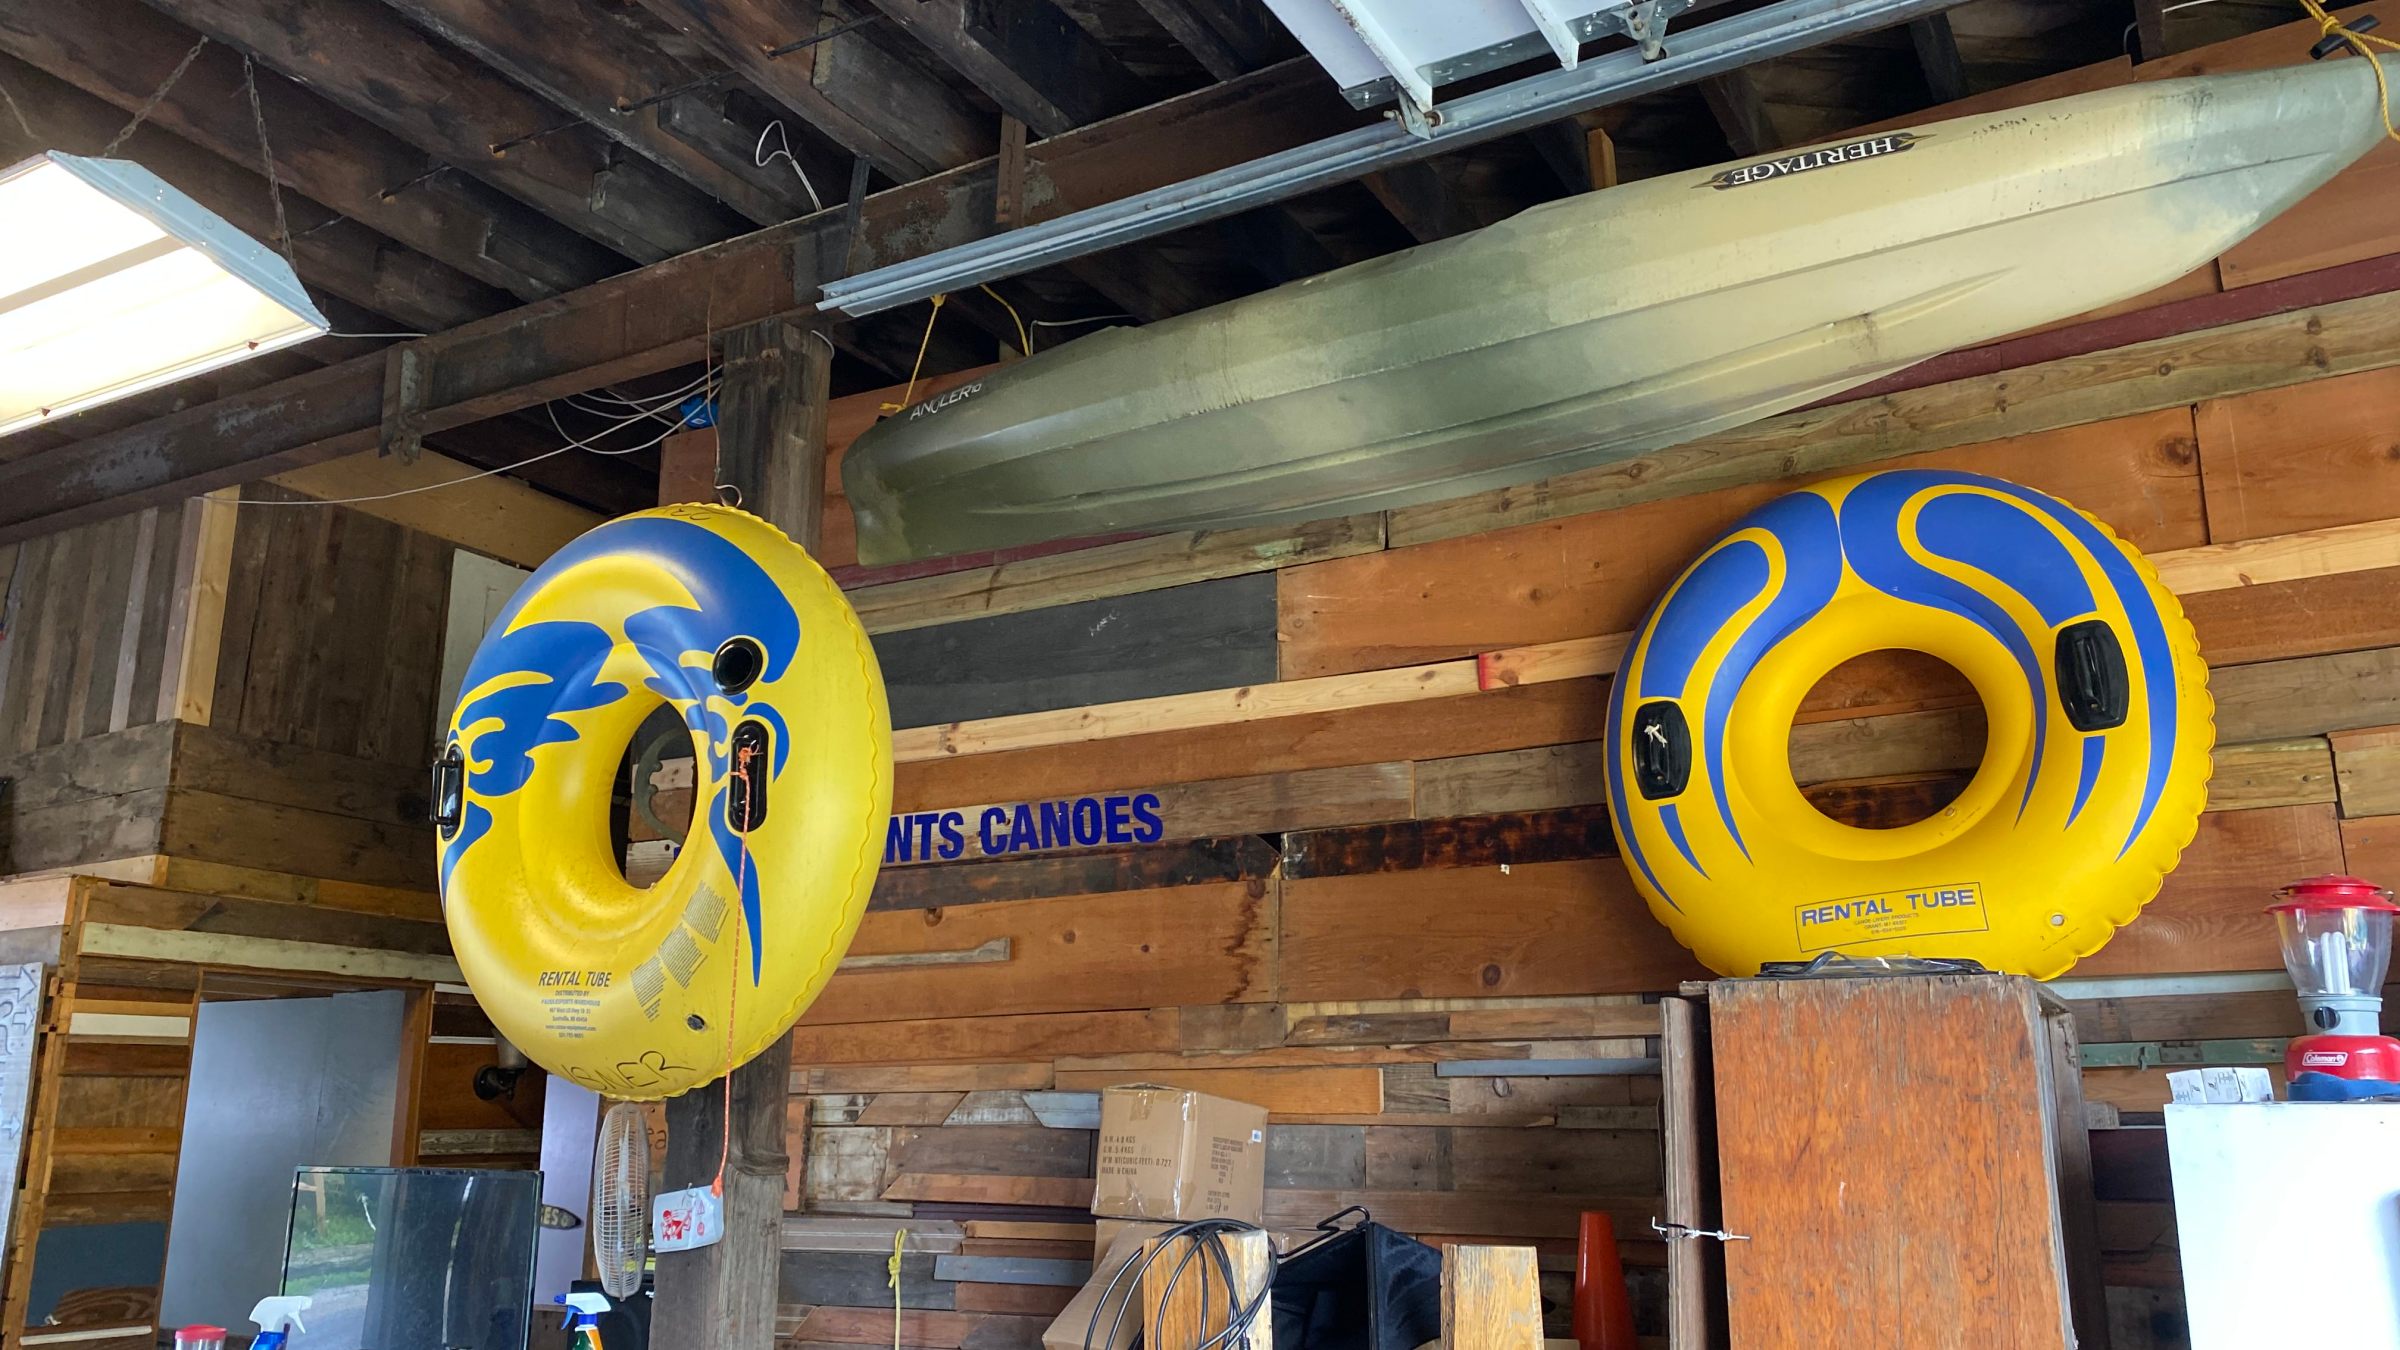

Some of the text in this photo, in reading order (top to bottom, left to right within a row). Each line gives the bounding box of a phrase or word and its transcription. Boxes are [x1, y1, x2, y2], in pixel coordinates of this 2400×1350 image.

[1731, 136, 1896, 185] HERITAGE
[884, 793, 1164, 864] NTS CANOES
[1801, 889, 1977, 927] RENTAL TUBE
[538, 970, 613, 988] RENTAL TUBE
[2306, 1053, 2337, 1064] Coleman
[1101, 1166, 1114, 1175] MADE
[1121, 1167, 1137, 1175] CHINA
